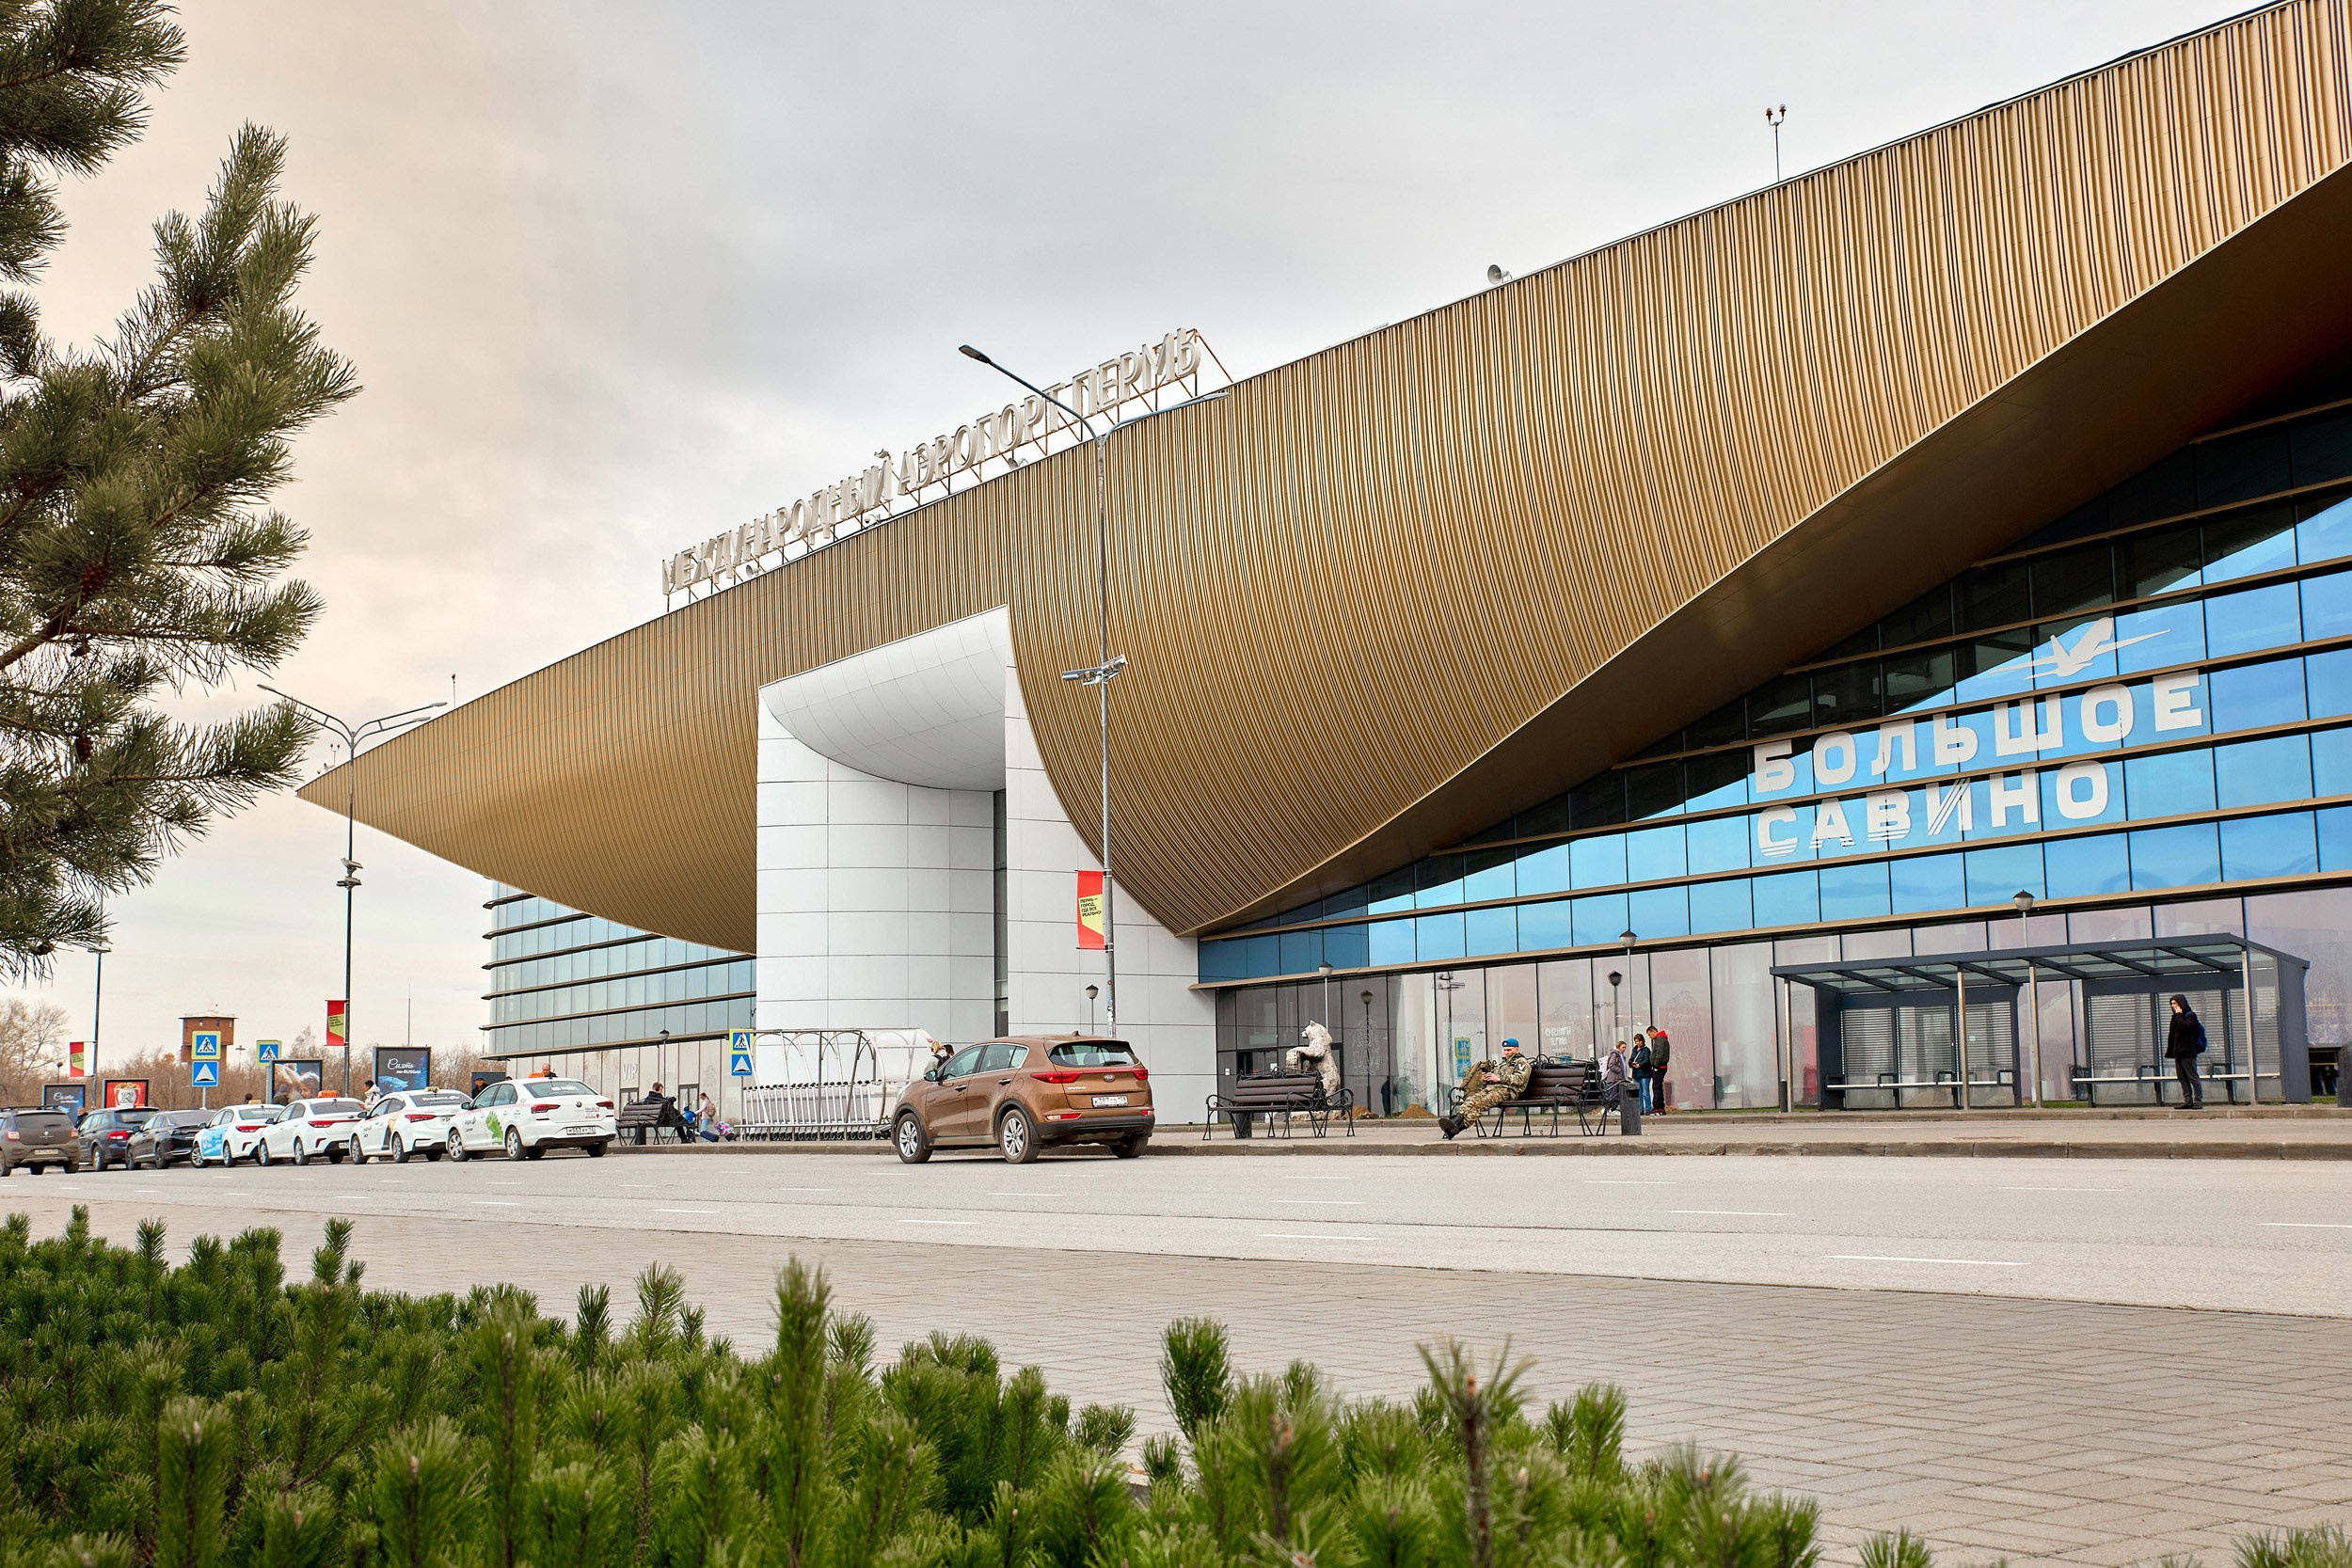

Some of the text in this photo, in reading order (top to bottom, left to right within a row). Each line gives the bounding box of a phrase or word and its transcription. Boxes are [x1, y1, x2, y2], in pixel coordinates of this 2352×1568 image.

[662, 327, 1201, 594] МЕЖДУНАРОДНЫЙ АЭРОПОРТ ПЕРМЬ
[1754, 669, 2204, 794] БОЛЬШОЕ
[1757, 760, 2109, 858] САВИНО
[623, 1063, 638, 1080] VIP
